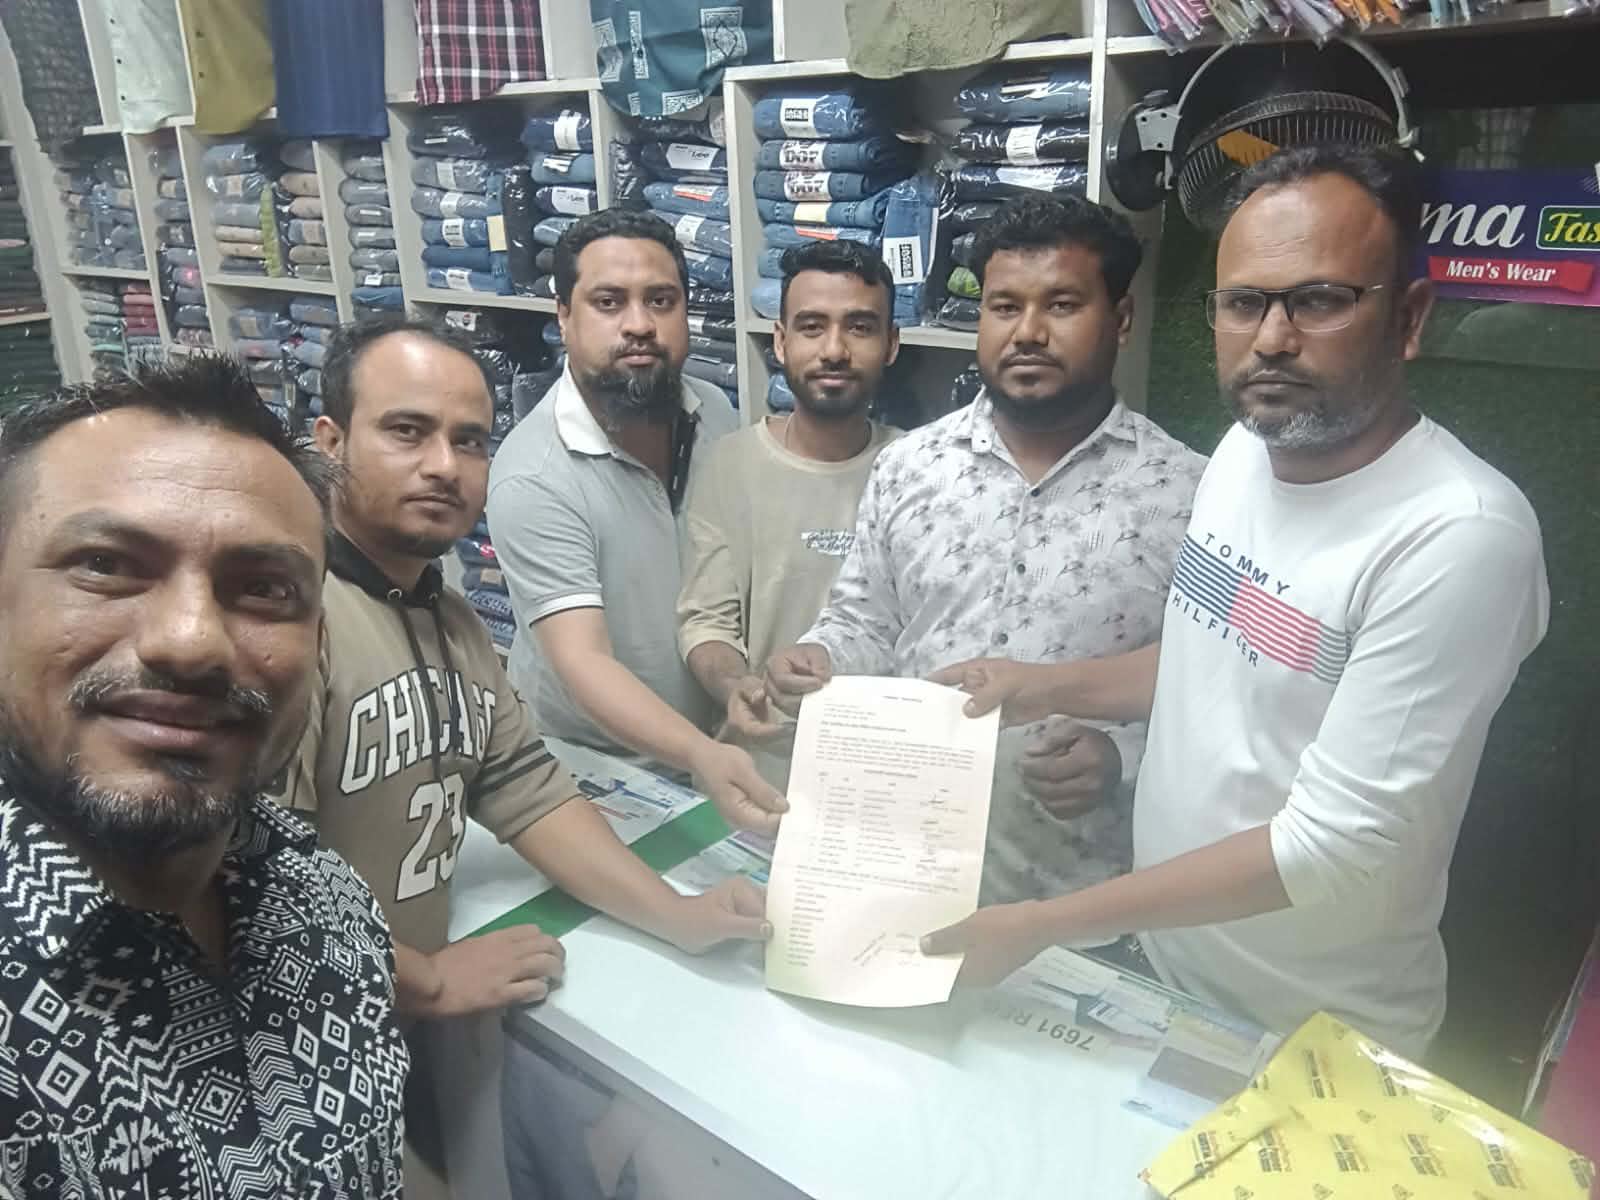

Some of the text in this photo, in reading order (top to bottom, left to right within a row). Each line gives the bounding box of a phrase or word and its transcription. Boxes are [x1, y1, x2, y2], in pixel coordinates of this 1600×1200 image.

[1446, 260, 1556, 282] Men's Wear
[1204, 532, 1291, 596] TOMMY
[395, 771, 467, 903] 23
[1037, 1018, 1097, 1050] 7691
